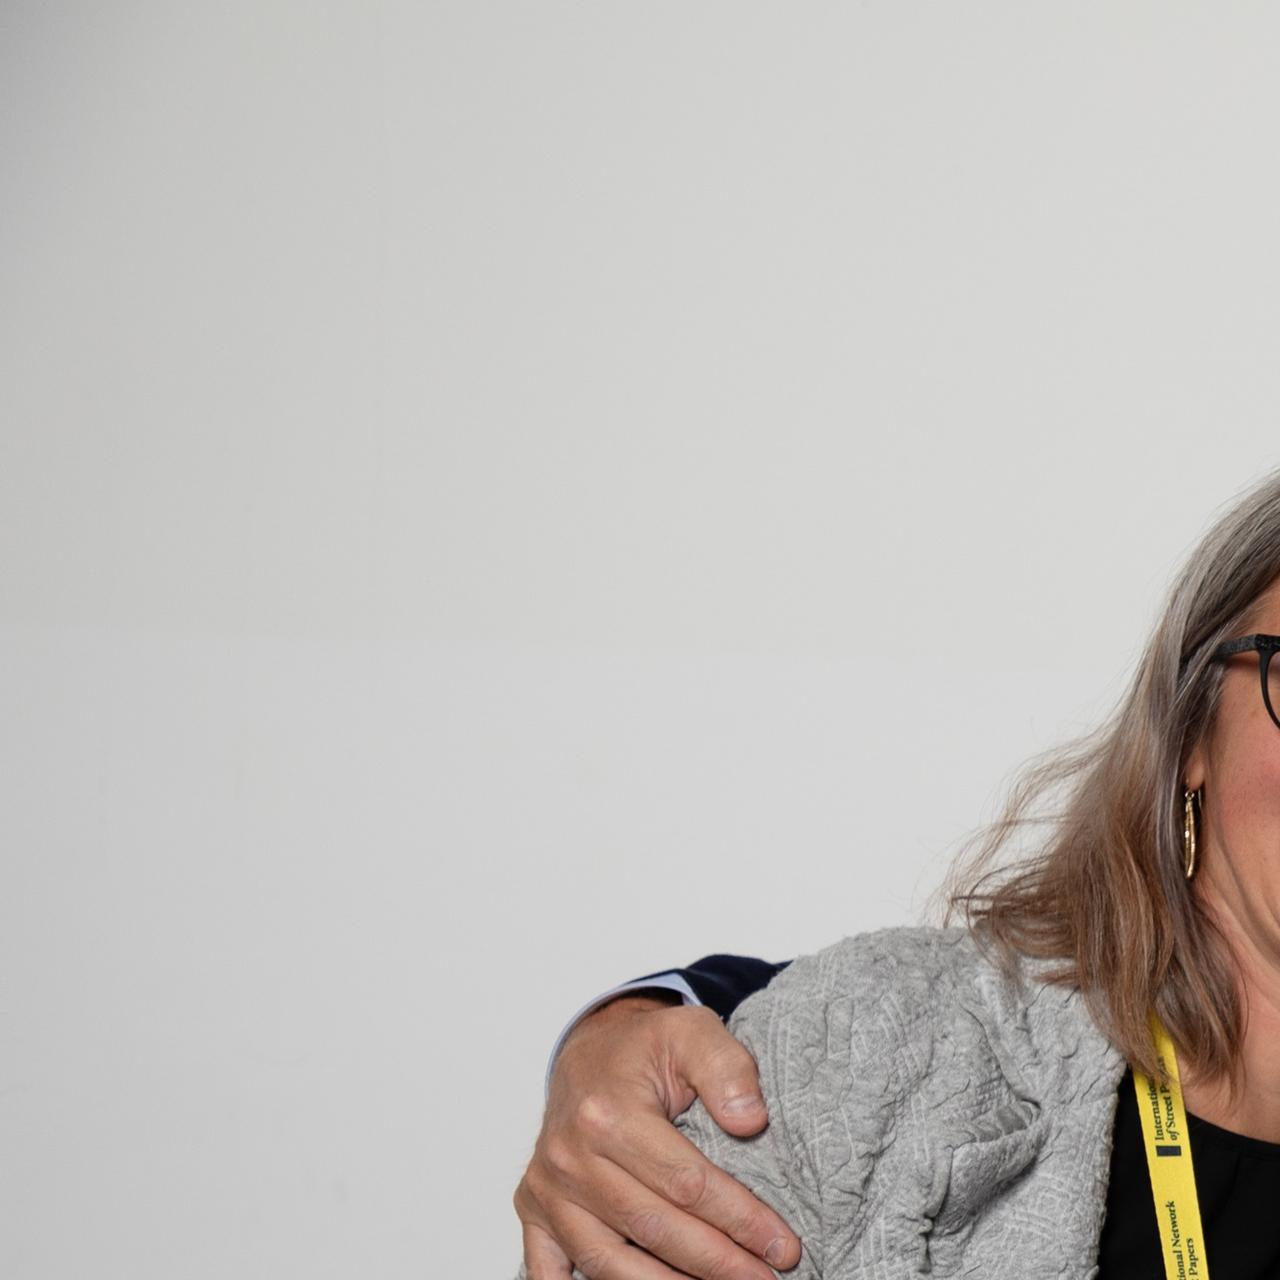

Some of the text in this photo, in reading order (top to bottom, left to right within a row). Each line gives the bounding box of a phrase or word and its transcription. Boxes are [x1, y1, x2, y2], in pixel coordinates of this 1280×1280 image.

[1162, 1096, 1176, 1128] Street
[1165, 1127, 1180, 1141] of
[1165, 1200, 1181, 1248] Network
[1186, 1238, 1199, 1276] Papers
